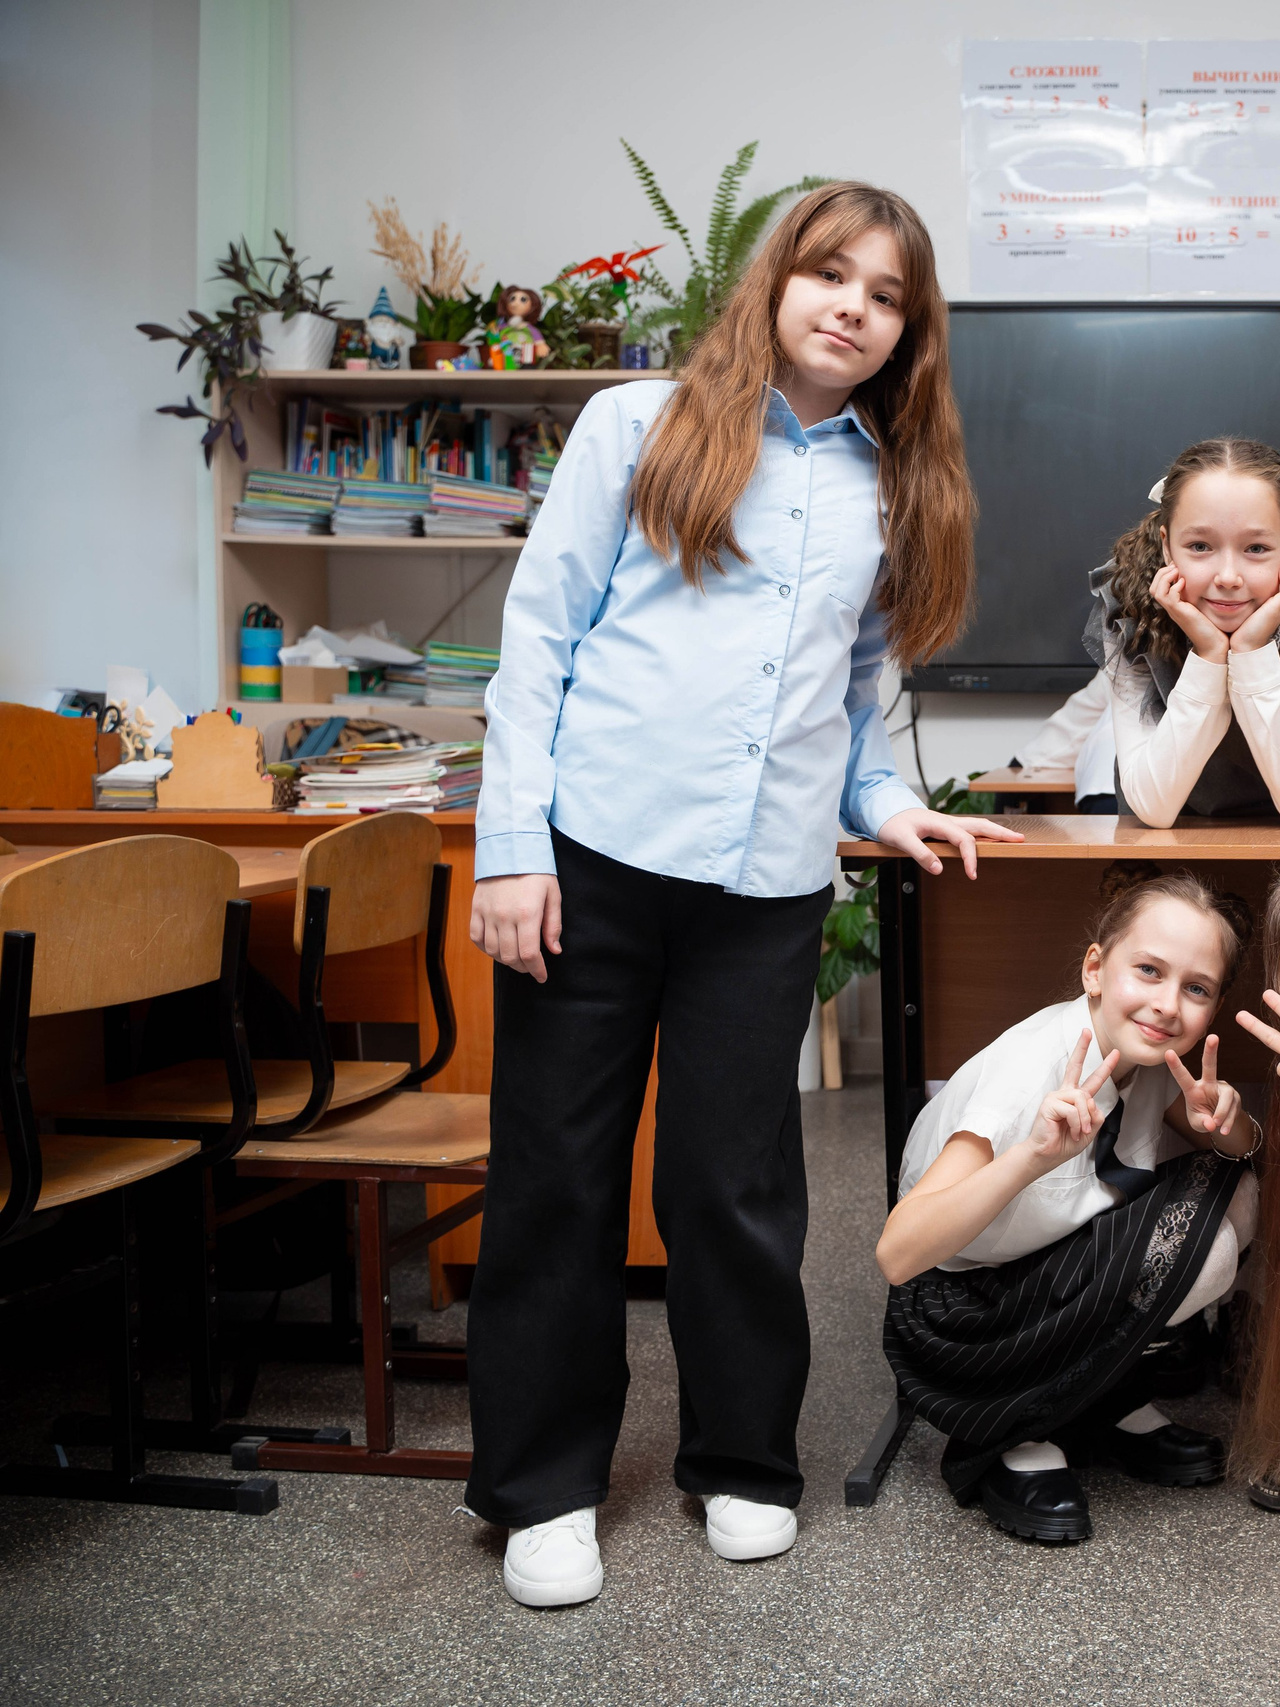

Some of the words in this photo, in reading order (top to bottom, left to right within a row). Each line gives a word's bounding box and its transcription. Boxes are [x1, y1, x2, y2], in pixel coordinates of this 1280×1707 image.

[1009, 65, 1102, 78] СЛОЖЕНИЕ
[1235, 101, 1245, 117] 2
[996, 224, 1008, 241] 3
[1054, 223, 1066, 240] 5
[1176, 227, 1197, 243] 10
[1228, 226, 1239, 244] 5
[1260, 1487, 1279, 1497] FREE
